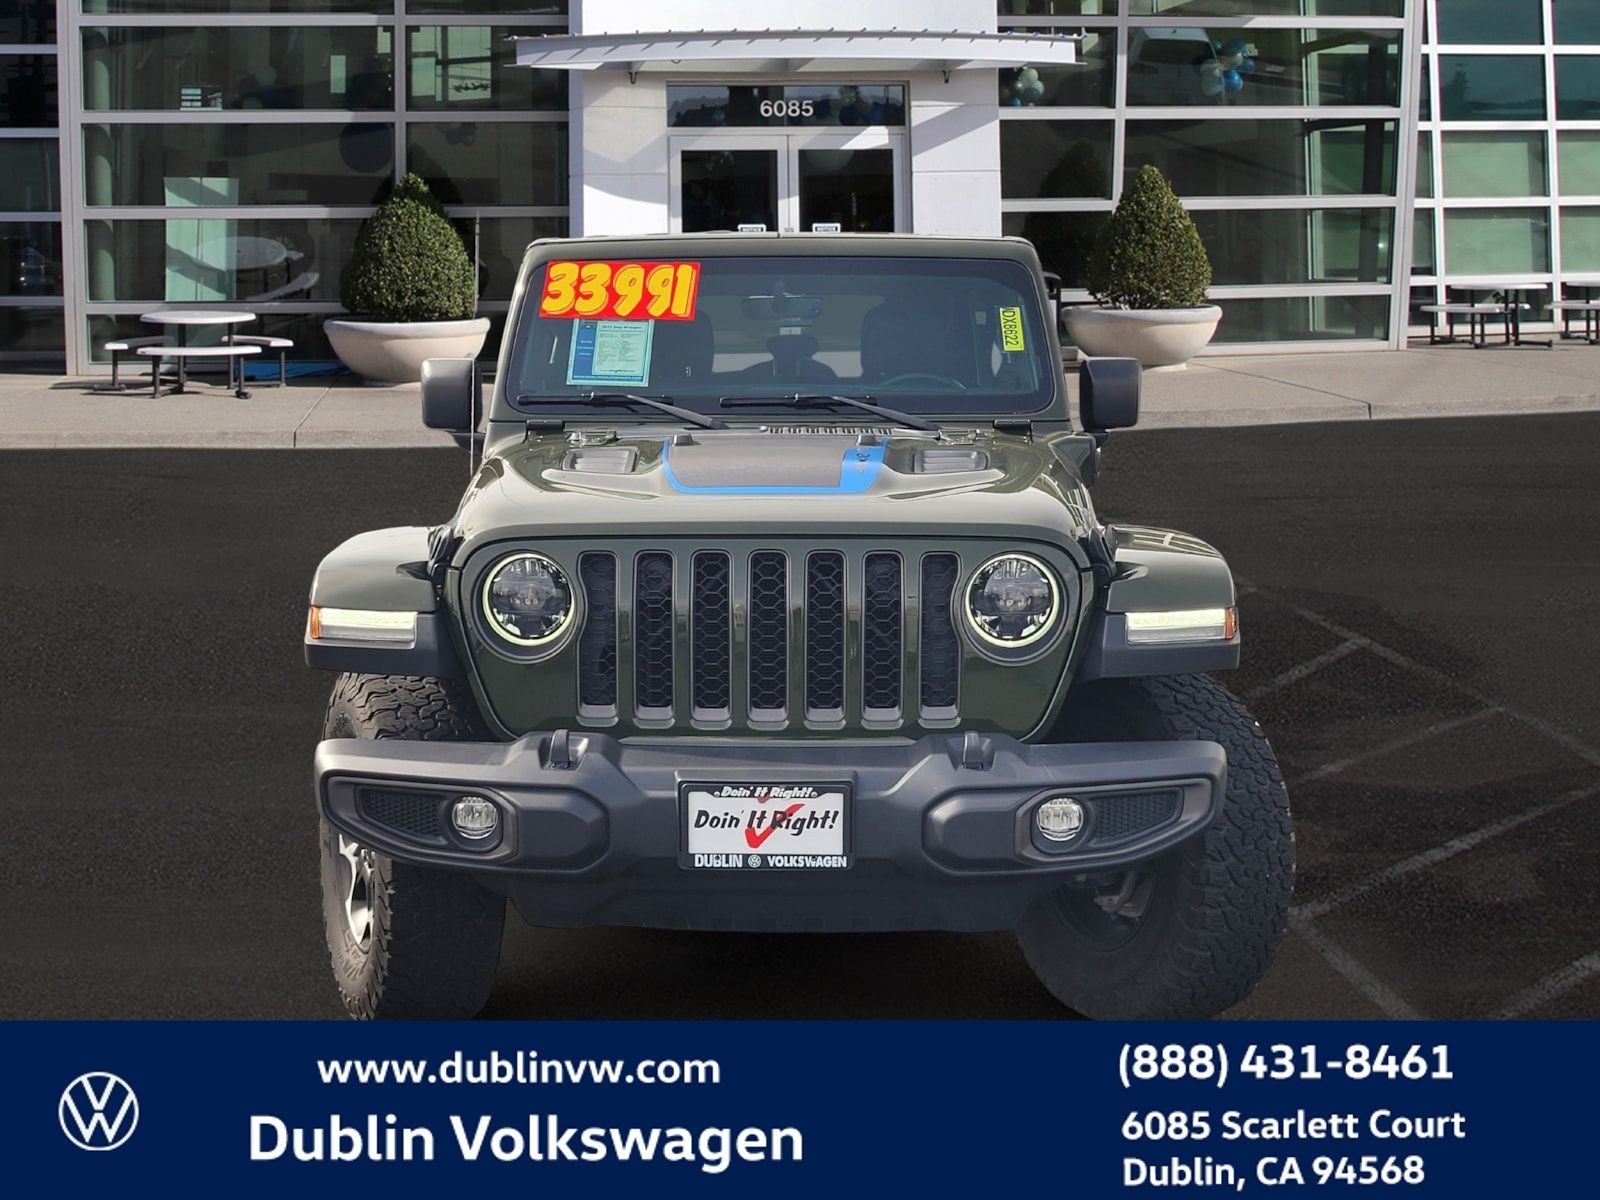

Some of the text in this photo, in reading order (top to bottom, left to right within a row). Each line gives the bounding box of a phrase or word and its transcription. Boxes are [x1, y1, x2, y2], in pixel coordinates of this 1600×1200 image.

[760, 100, 814, 117] 6085
[541, 262, 696, 317] 33991
[754, 787, 769, 797] It
[769, 787, 813, 800] Right!
[694, 810, 840, 836] Doin' It Right!
[694, 854, 743, 868] DUBLIN
[767, 856, 847, 868] VOLKSWAGEN
